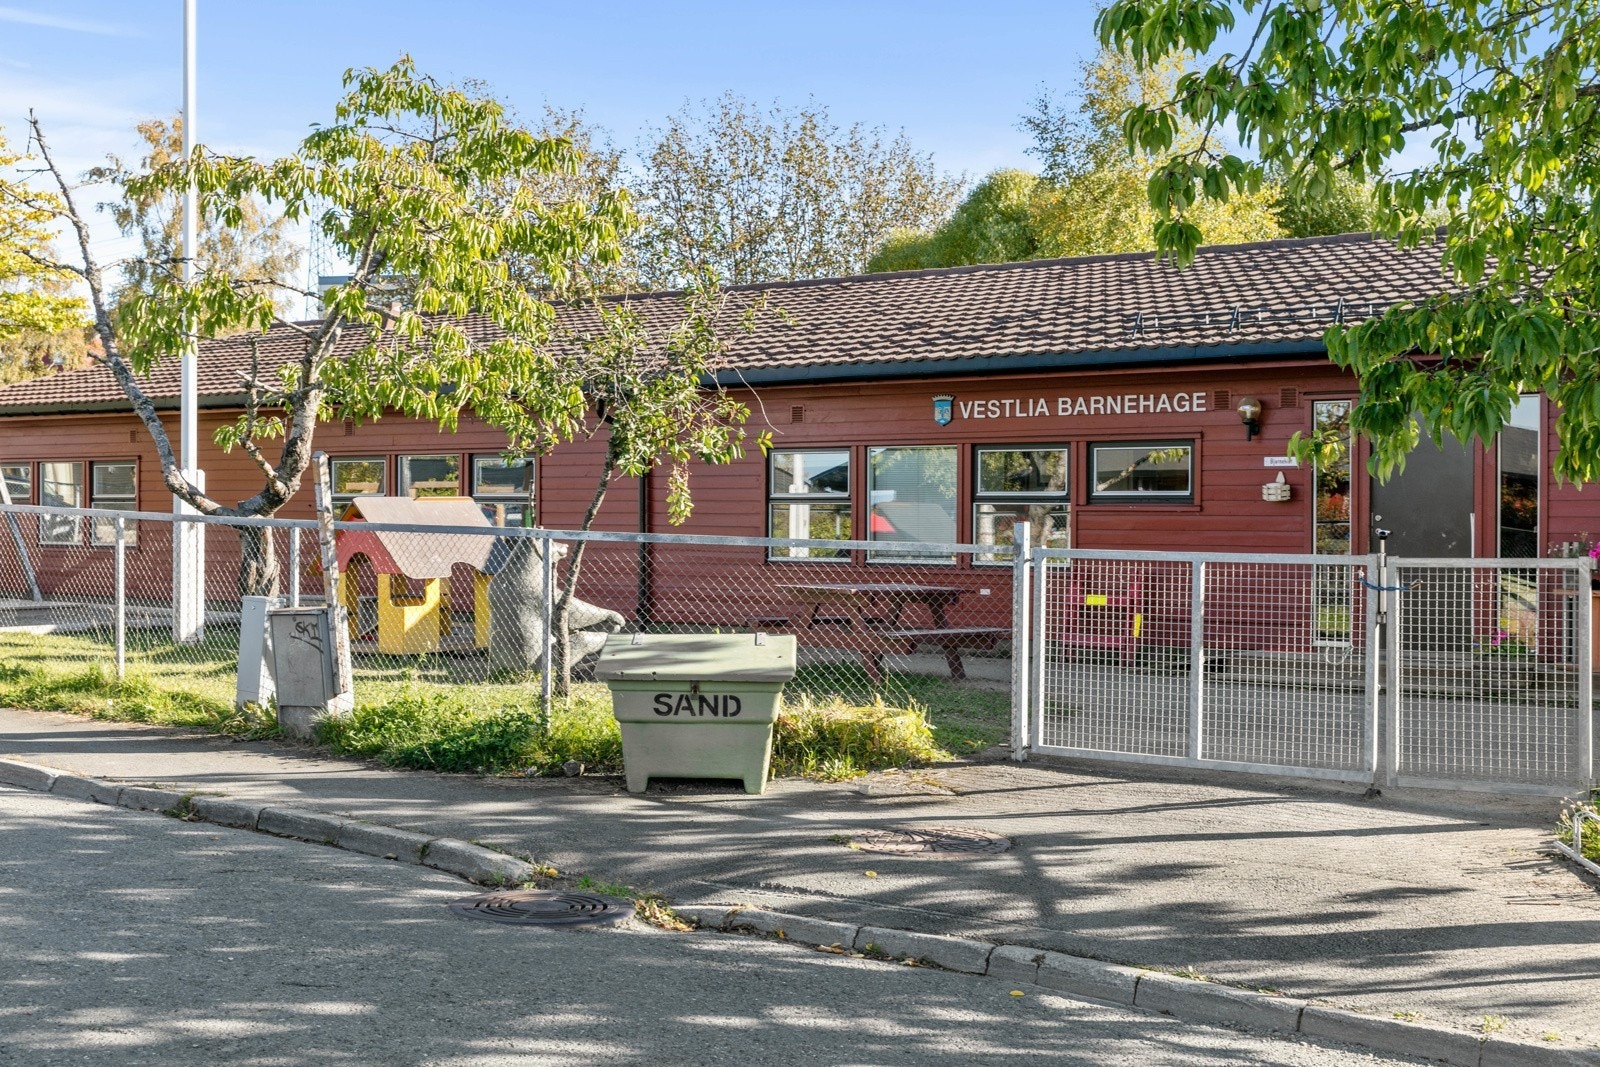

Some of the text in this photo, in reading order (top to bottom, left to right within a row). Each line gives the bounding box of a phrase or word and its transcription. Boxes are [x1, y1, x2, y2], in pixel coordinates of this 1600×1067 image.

[959, 392, 1207, 419] VESTLIA BARNEHAGE
[653, 693, 742, 717] SAND
